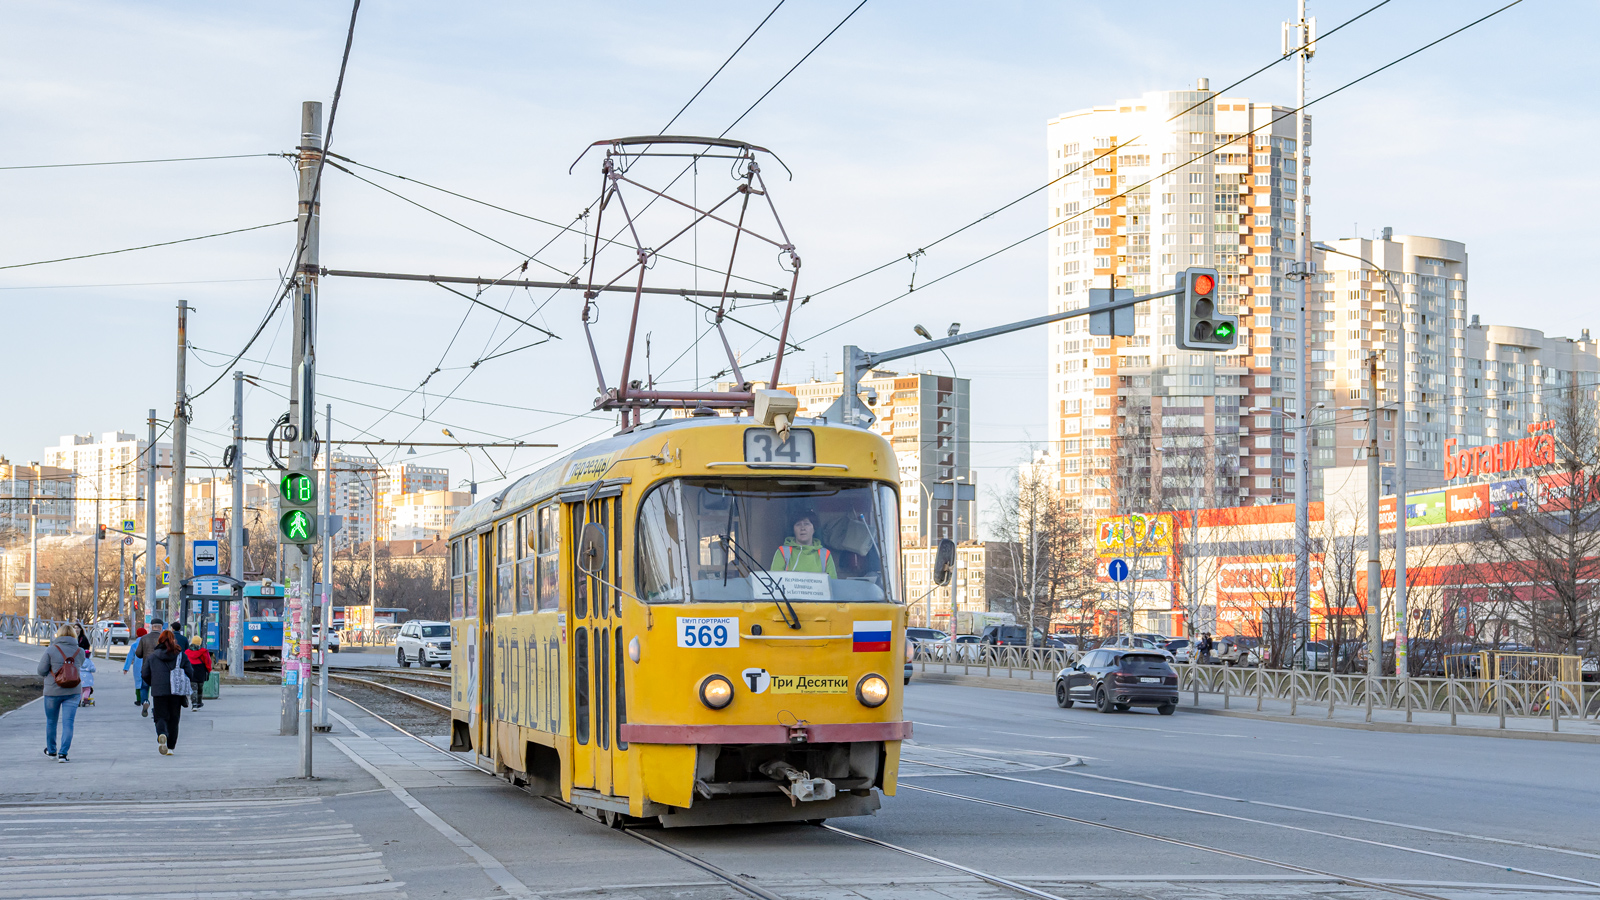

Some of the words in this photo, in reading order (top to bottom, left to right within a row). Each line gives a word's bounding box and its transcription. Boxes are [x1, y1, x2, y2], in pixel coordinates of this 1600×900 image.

[753, 434, 801, 467] 34
[1443, 433, 1555, 480] Ботаника
[568, 456, 611, 480] переезды
[286, 476, 311, 501] 18
[761, 577, 786, 596] 34
[684, 625, 728, 647] 569
[771, 676, 793, 690] Три
[796, 676, 848, 690] Десятки
